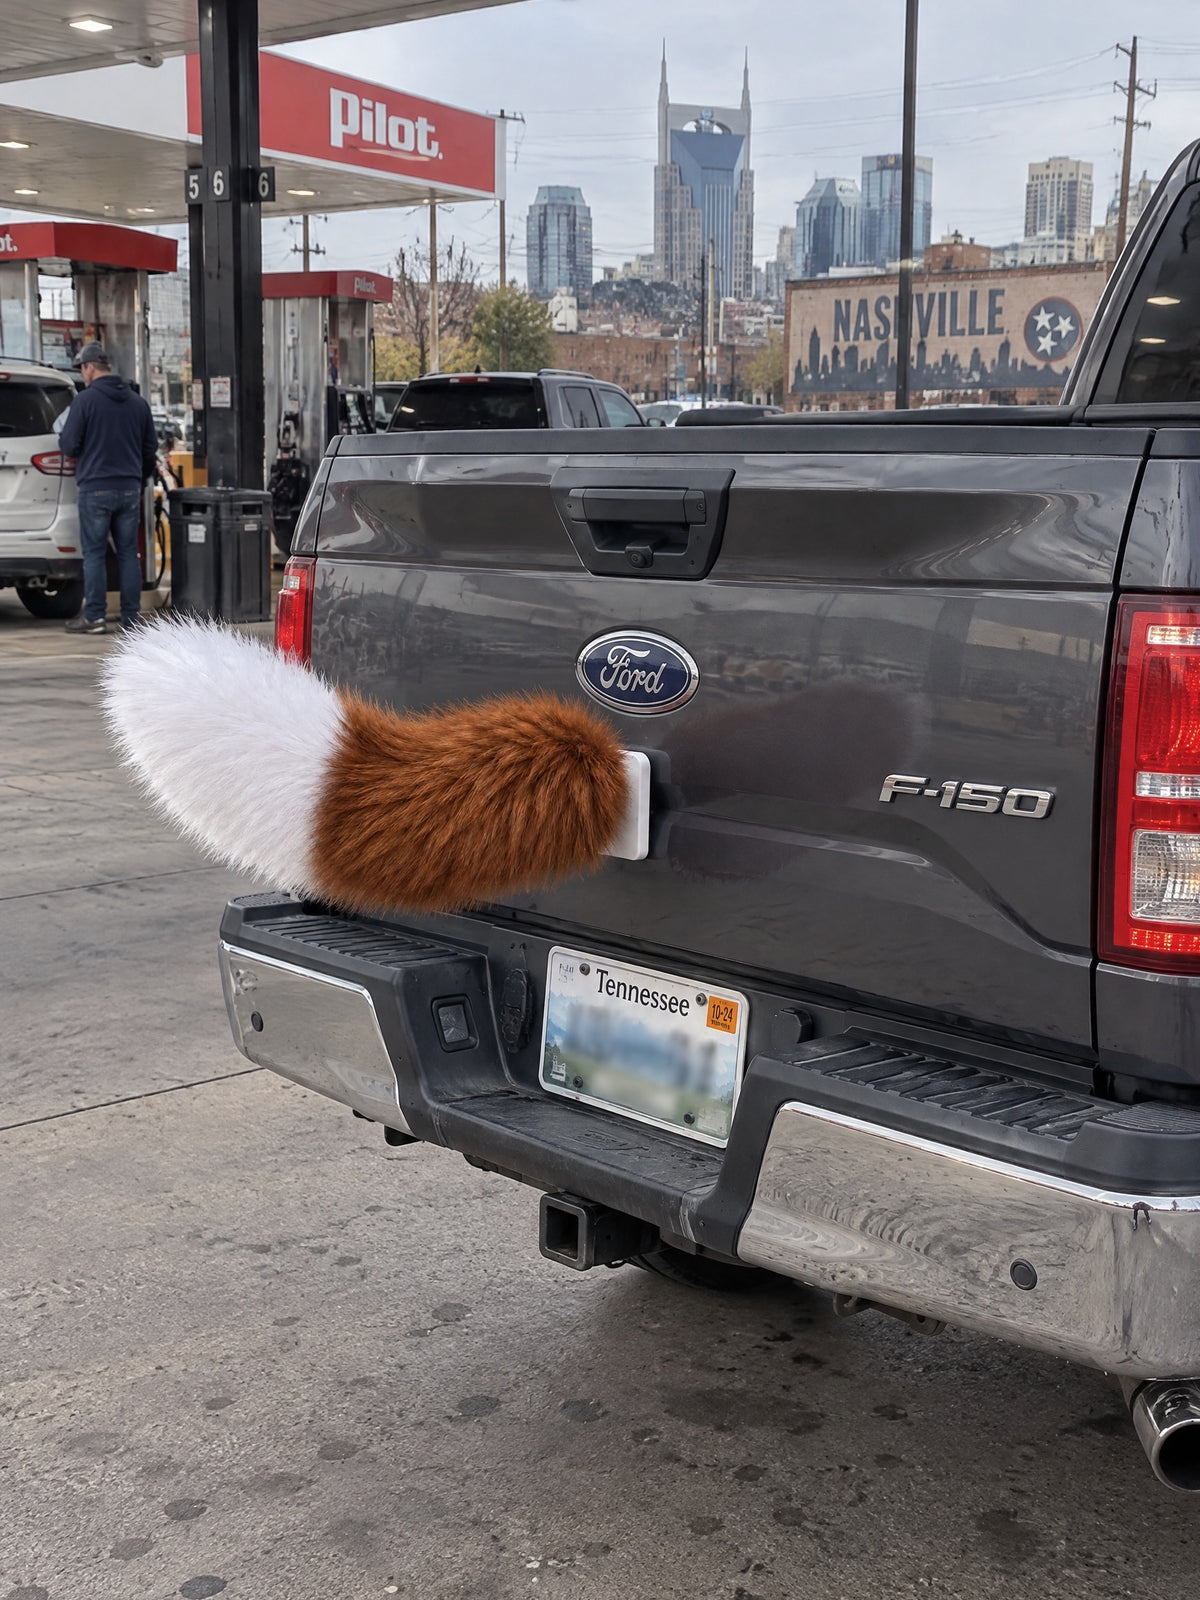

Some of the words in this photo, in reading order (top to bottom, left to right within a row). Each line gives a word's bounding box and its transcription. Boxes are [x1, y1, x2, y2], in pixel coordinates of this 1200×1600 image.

[190, 174, 199, 199] 5
[213, 170, 224, 196] 6
[258, 172, 269, 198] 6
[600, 645, 667, 694] Ford
[879, 774, 1054, 819] F-150
[596, 968, 690, 1016] Tennessee
